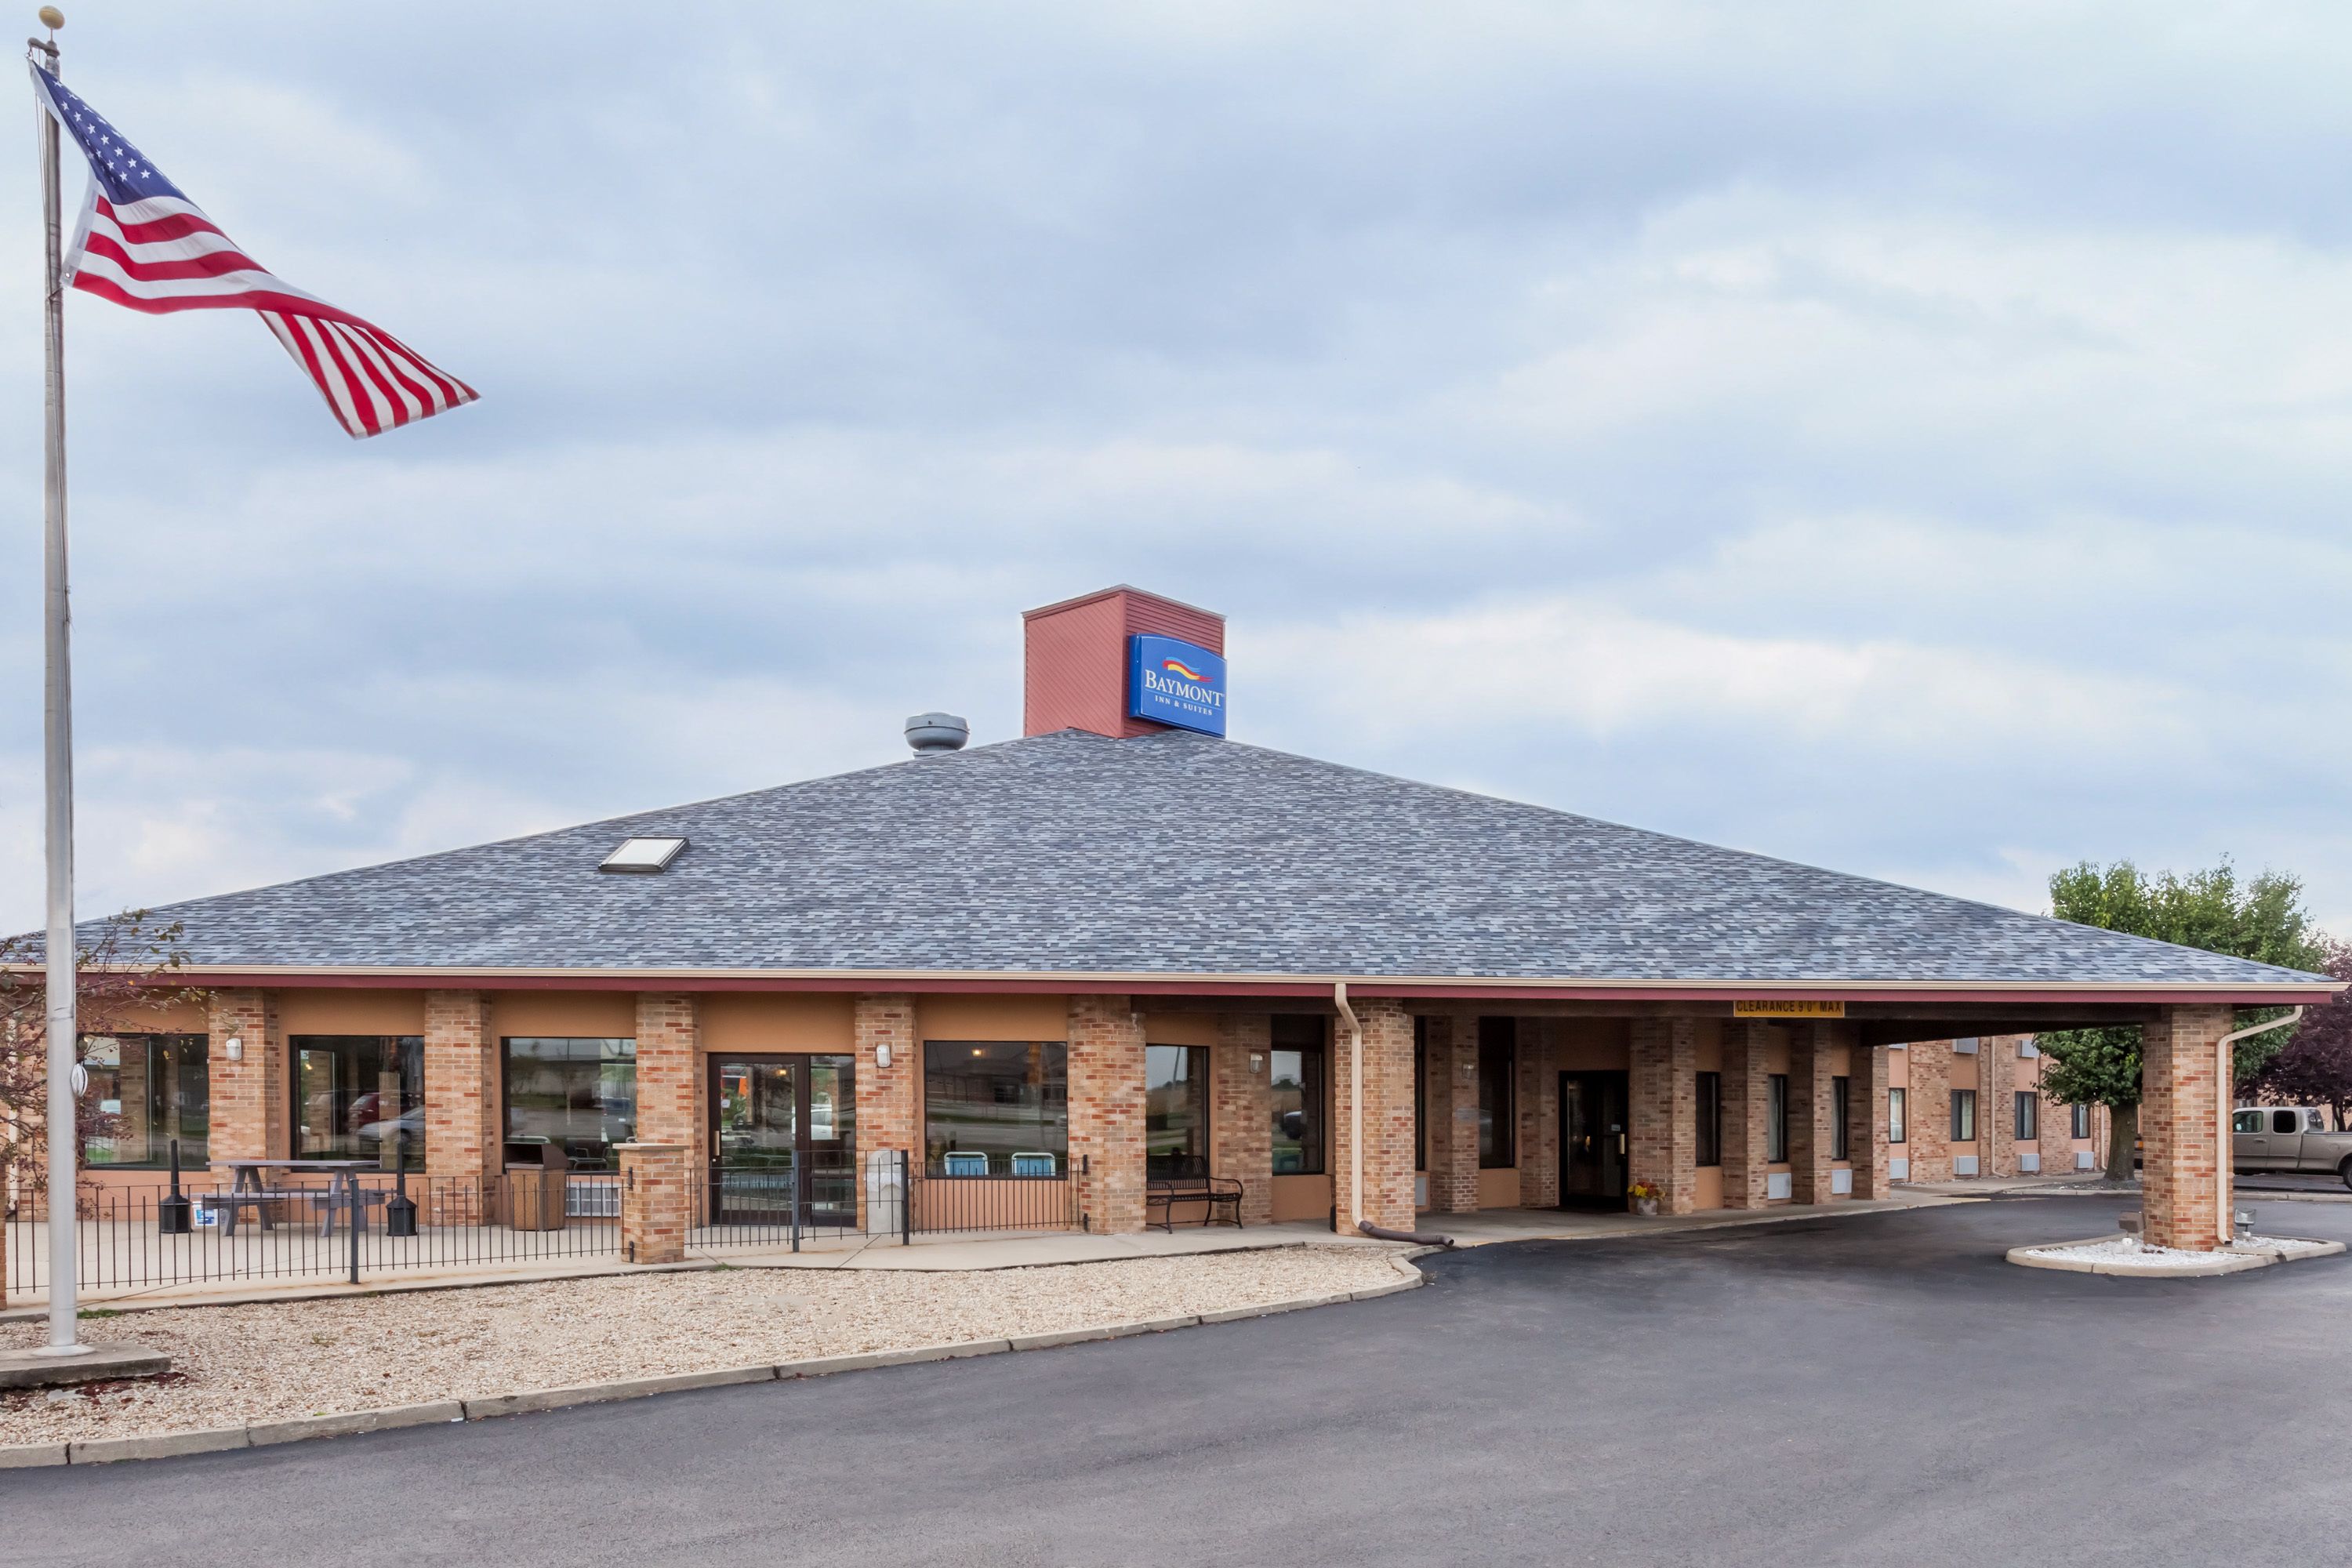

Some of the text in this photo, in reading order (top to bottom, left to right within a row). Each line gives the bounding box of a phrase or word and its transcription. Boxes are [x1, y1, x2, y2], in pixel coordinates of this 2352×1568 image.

[1145, 669, 1224, 707] BAYMONT
[1155, 695, 1171, 705] INN
[1183, 702, 1213, 716] SUITES
[1737, 1000, 1795, 1012] CLEARANCE
[1820, 1000, 1841, 1012] MAX
